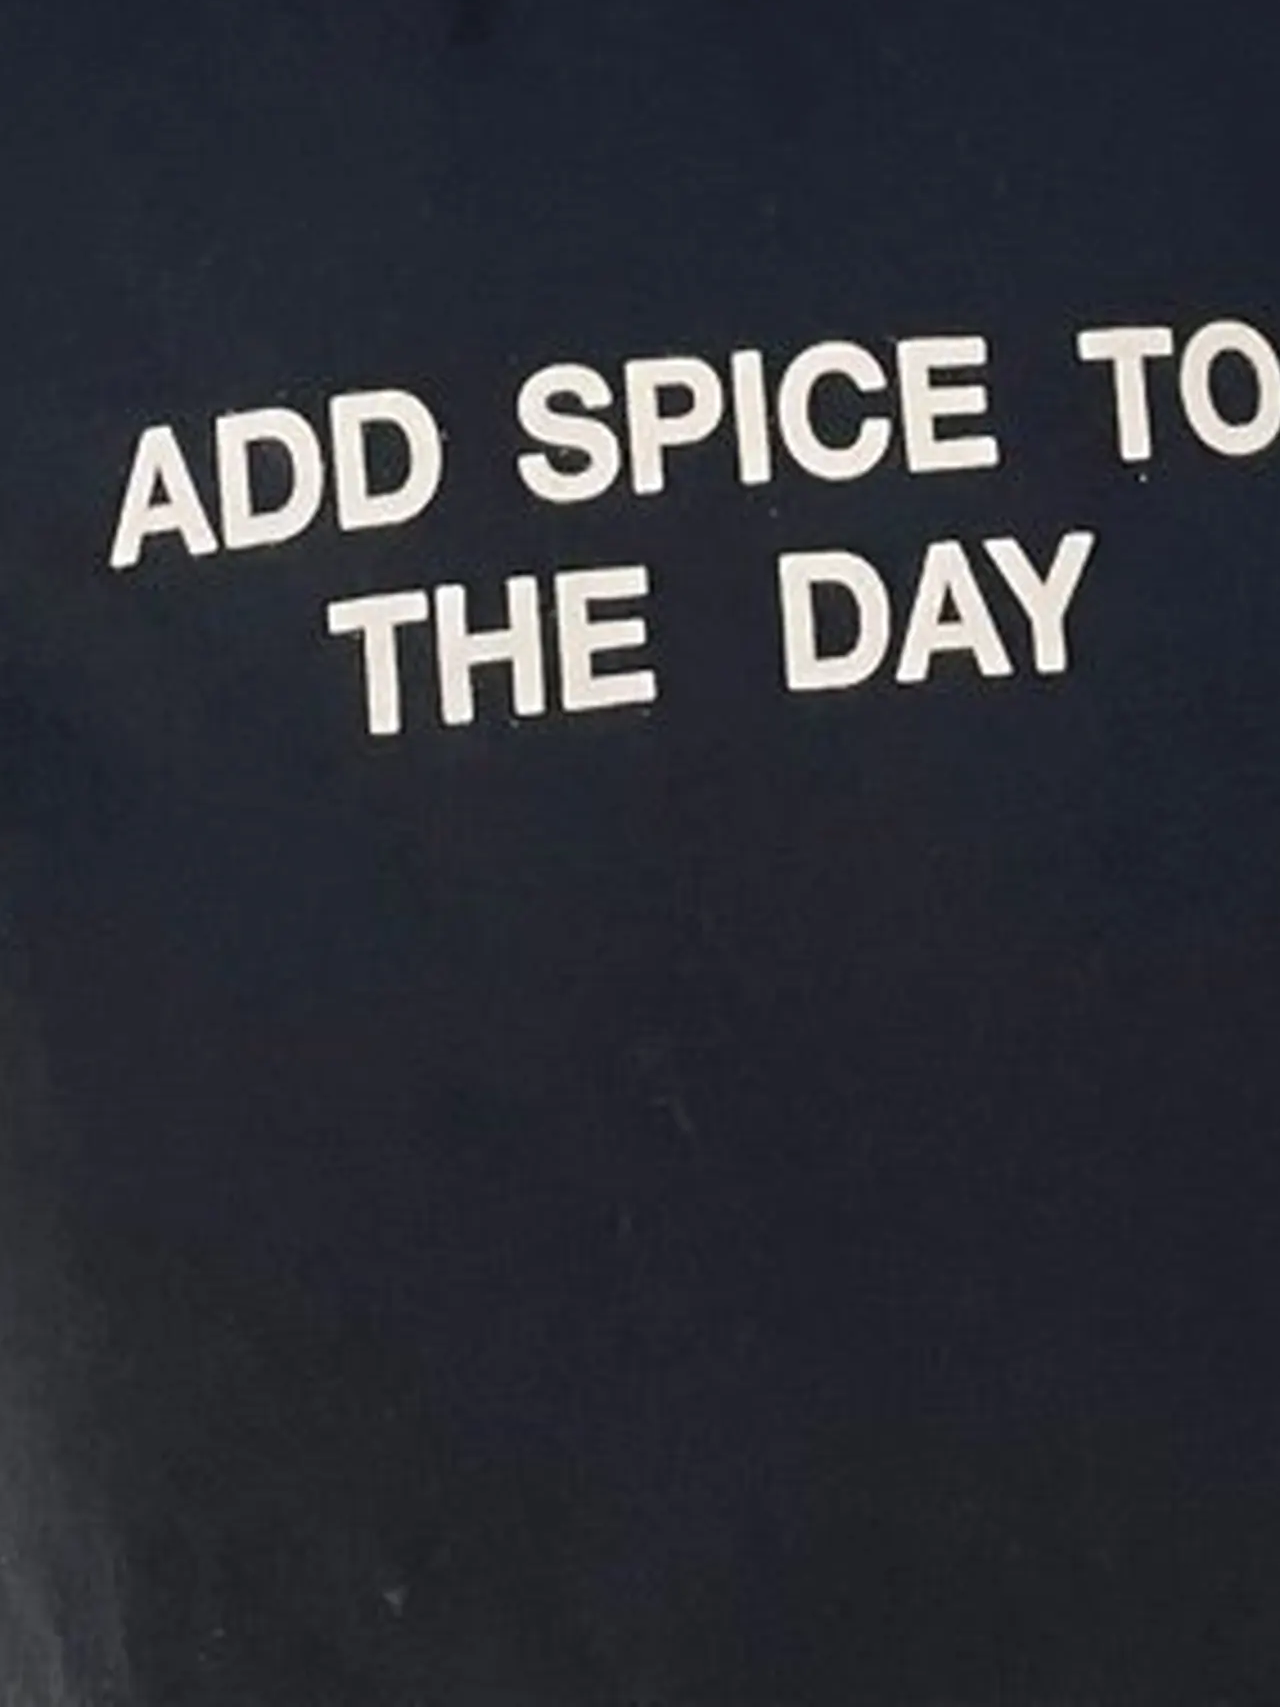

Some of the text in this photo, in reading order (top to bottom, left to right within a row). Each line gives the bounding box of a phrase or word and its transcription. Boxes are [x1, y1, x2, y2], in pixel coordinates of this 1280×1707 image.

[109, 390, 442, 568] ADD
[517, 336, 998, 502] SPICE
[327, 532, 1094, 735] THE DAY
